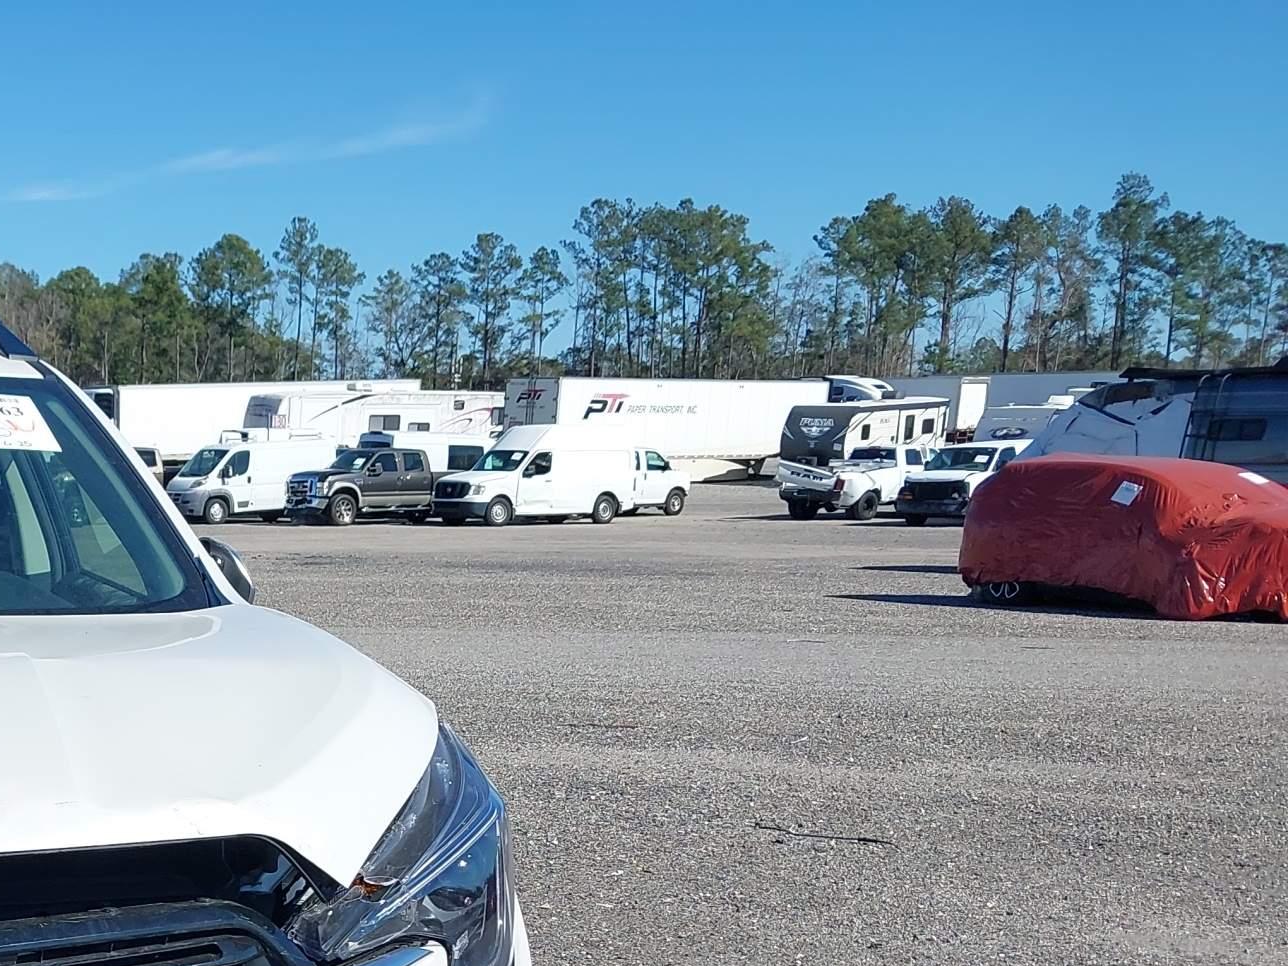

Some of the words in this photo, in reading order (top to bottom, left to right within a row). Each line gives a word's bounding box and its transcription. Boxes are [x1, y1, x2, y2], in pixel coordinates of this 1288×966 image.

[626, 404, 647, 414] PAPER
[649, 404, 684, 414] TRANSPORT
[790, 470, 824, 482] RAM
